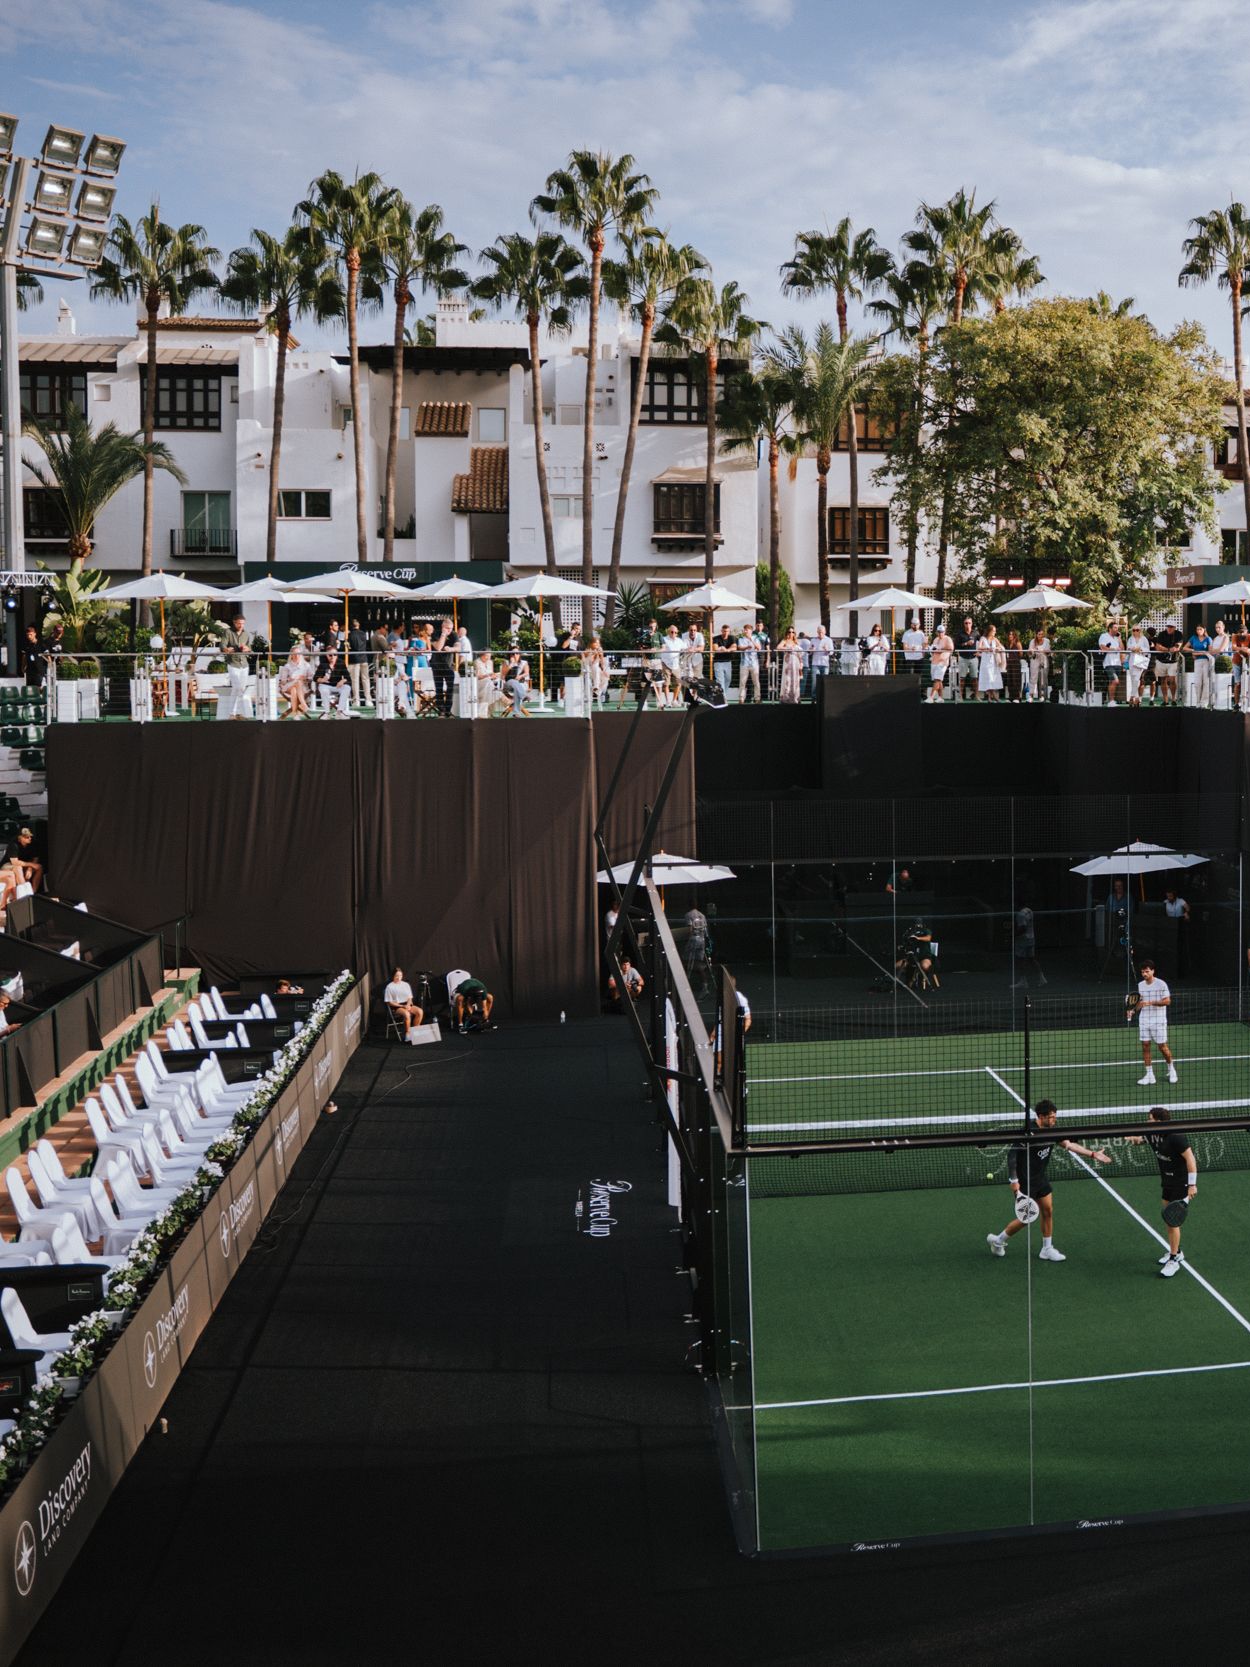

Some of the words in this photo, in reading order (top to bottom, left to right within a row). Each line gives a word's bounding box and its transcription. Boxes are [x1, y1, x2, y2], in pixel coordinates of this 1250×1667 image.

[393, 568, 416, 581] Cup
[583, 1217, 618, 1237] Cup
[156, 1284, 189, 1351] Discovery
[38, 1441, 91, 1541] Discovery
[44, 1525, 61, 1557] LAND
[62, 1481, 89, 1527] COMPANY
